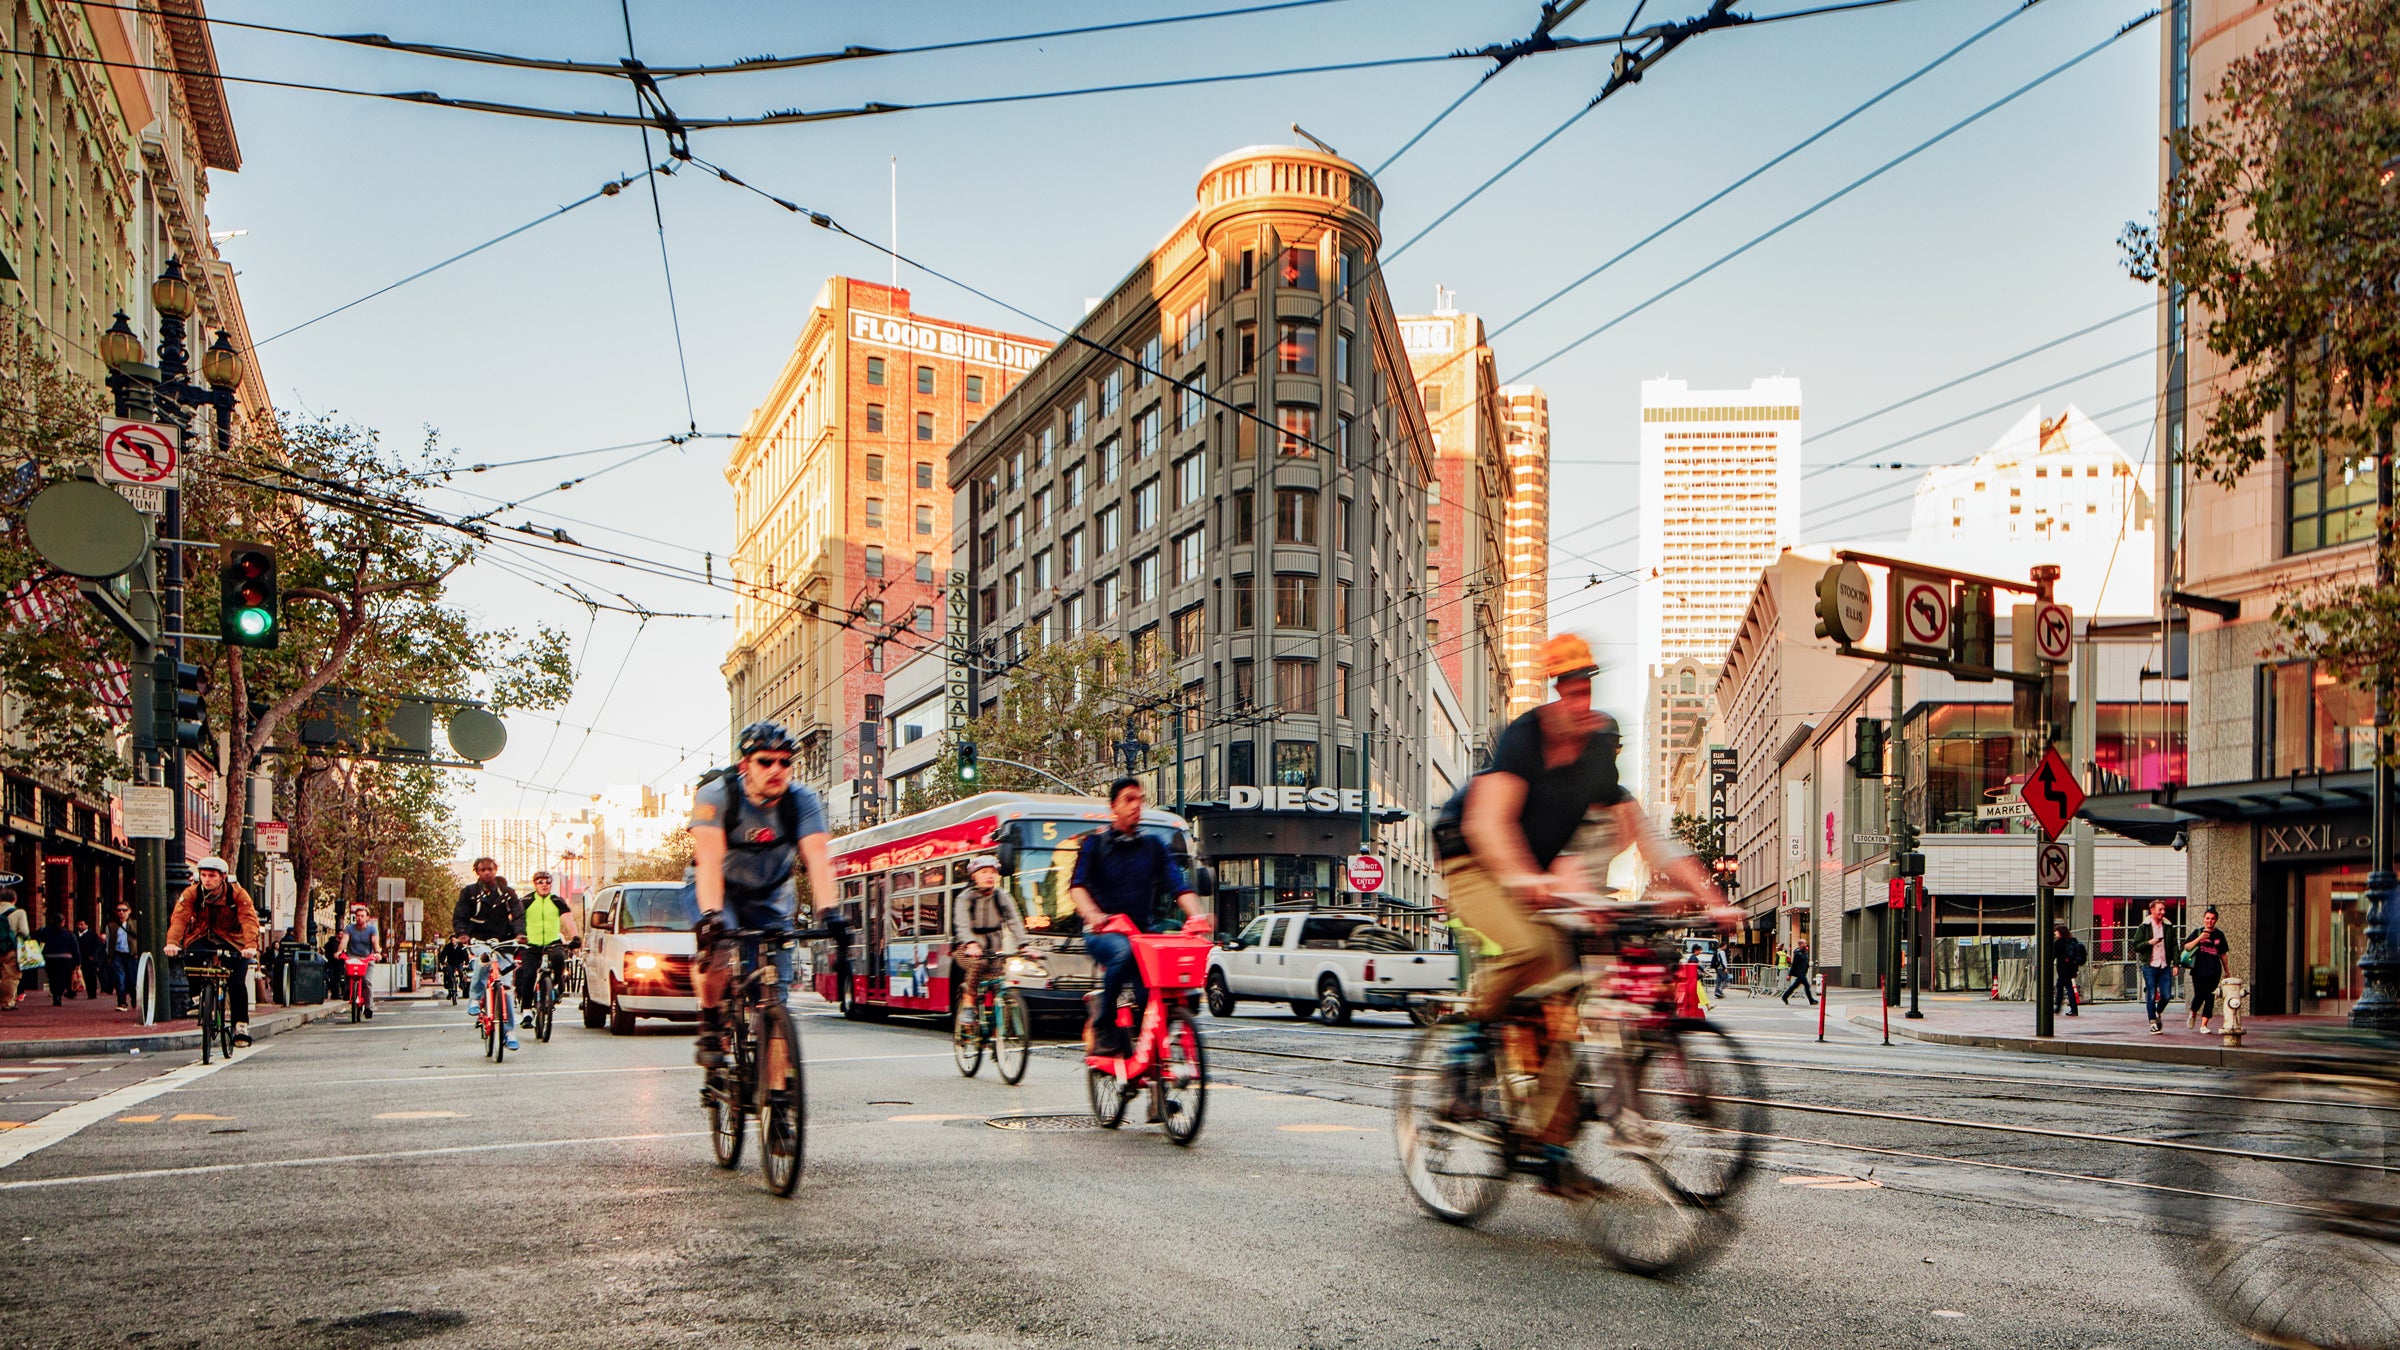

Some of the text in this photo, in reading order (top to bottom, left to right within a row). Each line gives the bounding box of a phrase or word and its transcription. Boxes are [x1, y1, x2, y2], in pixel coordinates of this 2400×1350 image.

[854, 314, 1048, 369] FLOOD BUILDIN
[122, 486, 159, 500] EXCEPT
[131, 499, 156, 511] UNI
[1840, 582, 1869, 605] STOCKTON
[1845, 605, 1863, 624] ELLIS
[1229, 785, 1388, 816] DIESEL
[1986, 804, 2027, 816] MARKET
[1042, 821, 1058, 841] 5
[1856, 835, 1887, 843] STOCKTON
[2267, 824, 2332, 853] XXI
[1791, 838, 1799, 856] CB2
